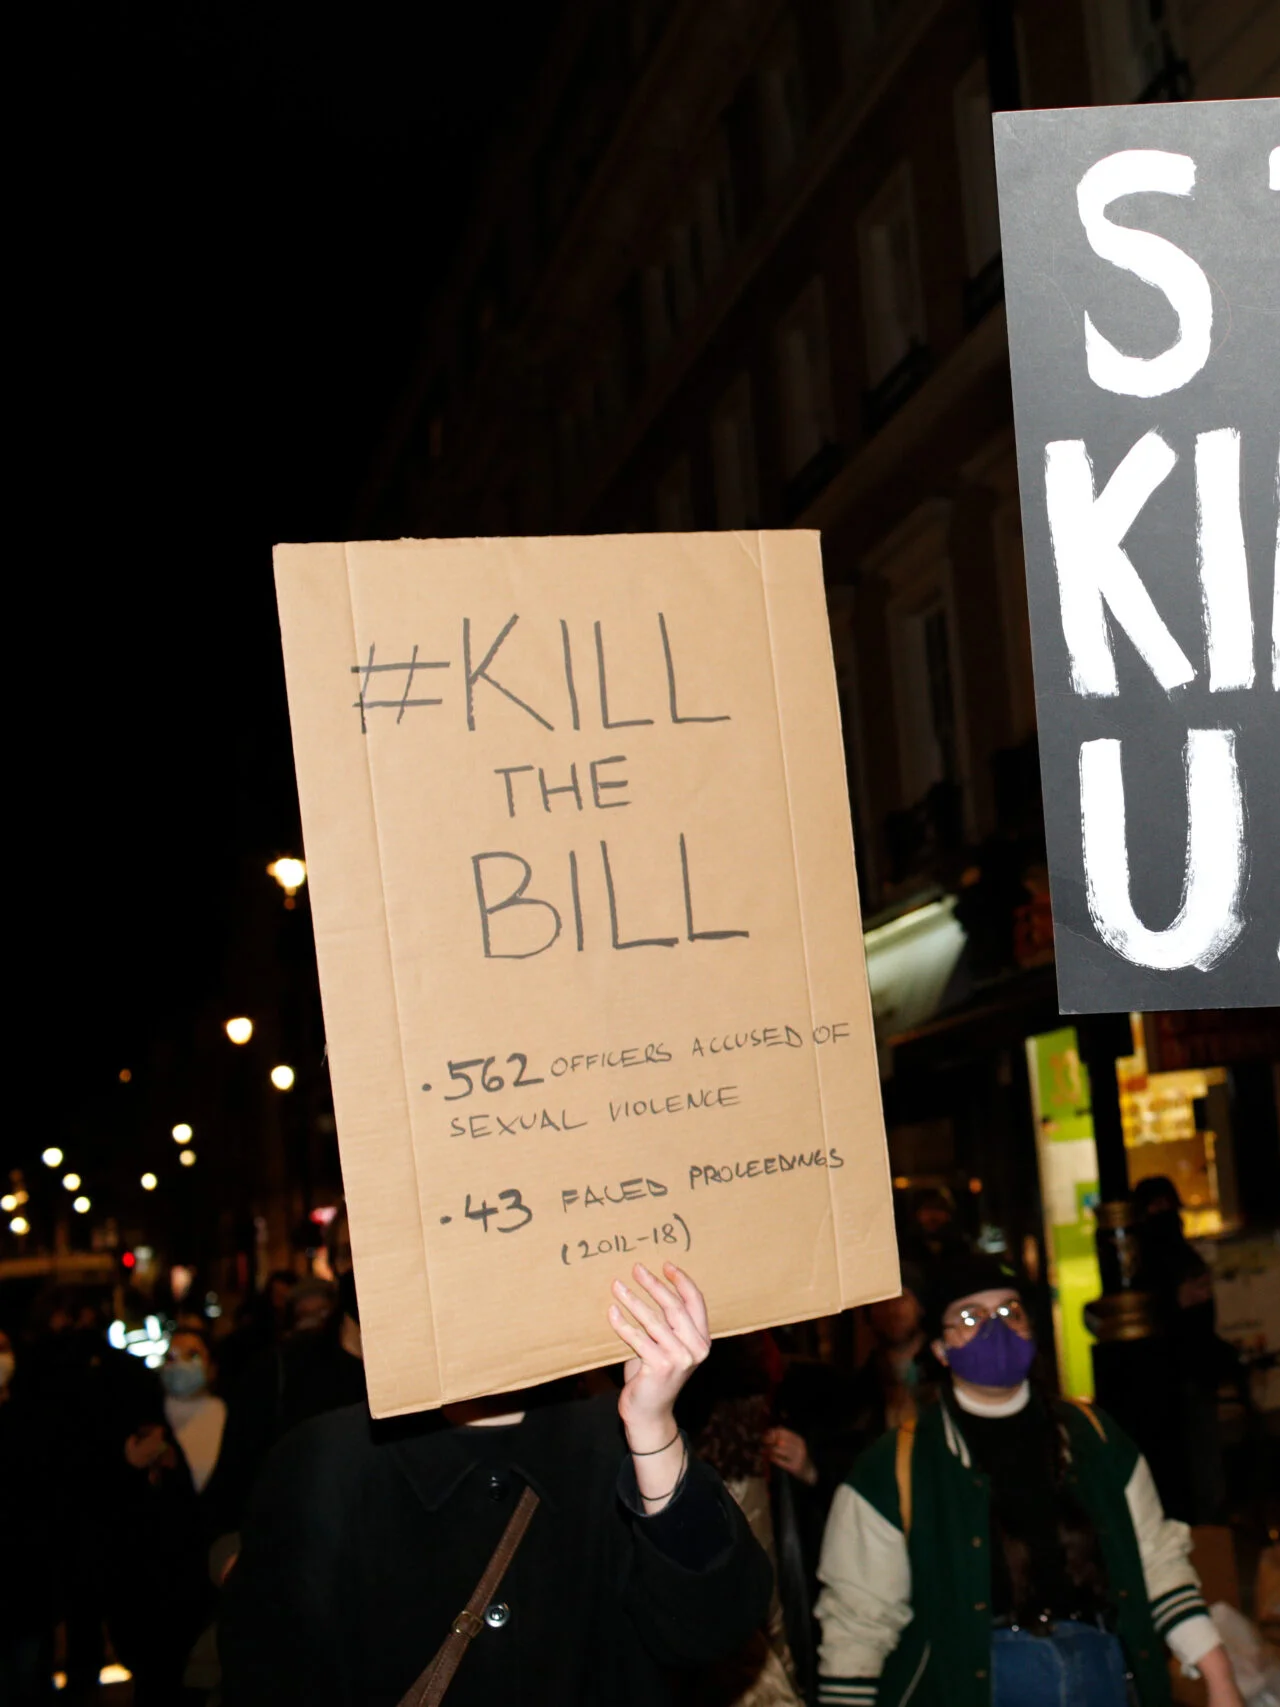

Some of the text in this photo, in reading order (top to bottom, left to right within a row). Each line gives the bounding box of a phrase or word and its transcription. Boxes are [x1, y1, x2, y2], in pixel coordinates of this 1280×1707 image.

[351, 612, 731, 734] #KILL
[494, 755, 631, 818] THE
[471, 832, 750, 959] BILL
[812, 1022, 850, 1044] OF
[450, 1085, 740, 1139] SEXUAL VIOLENCE
